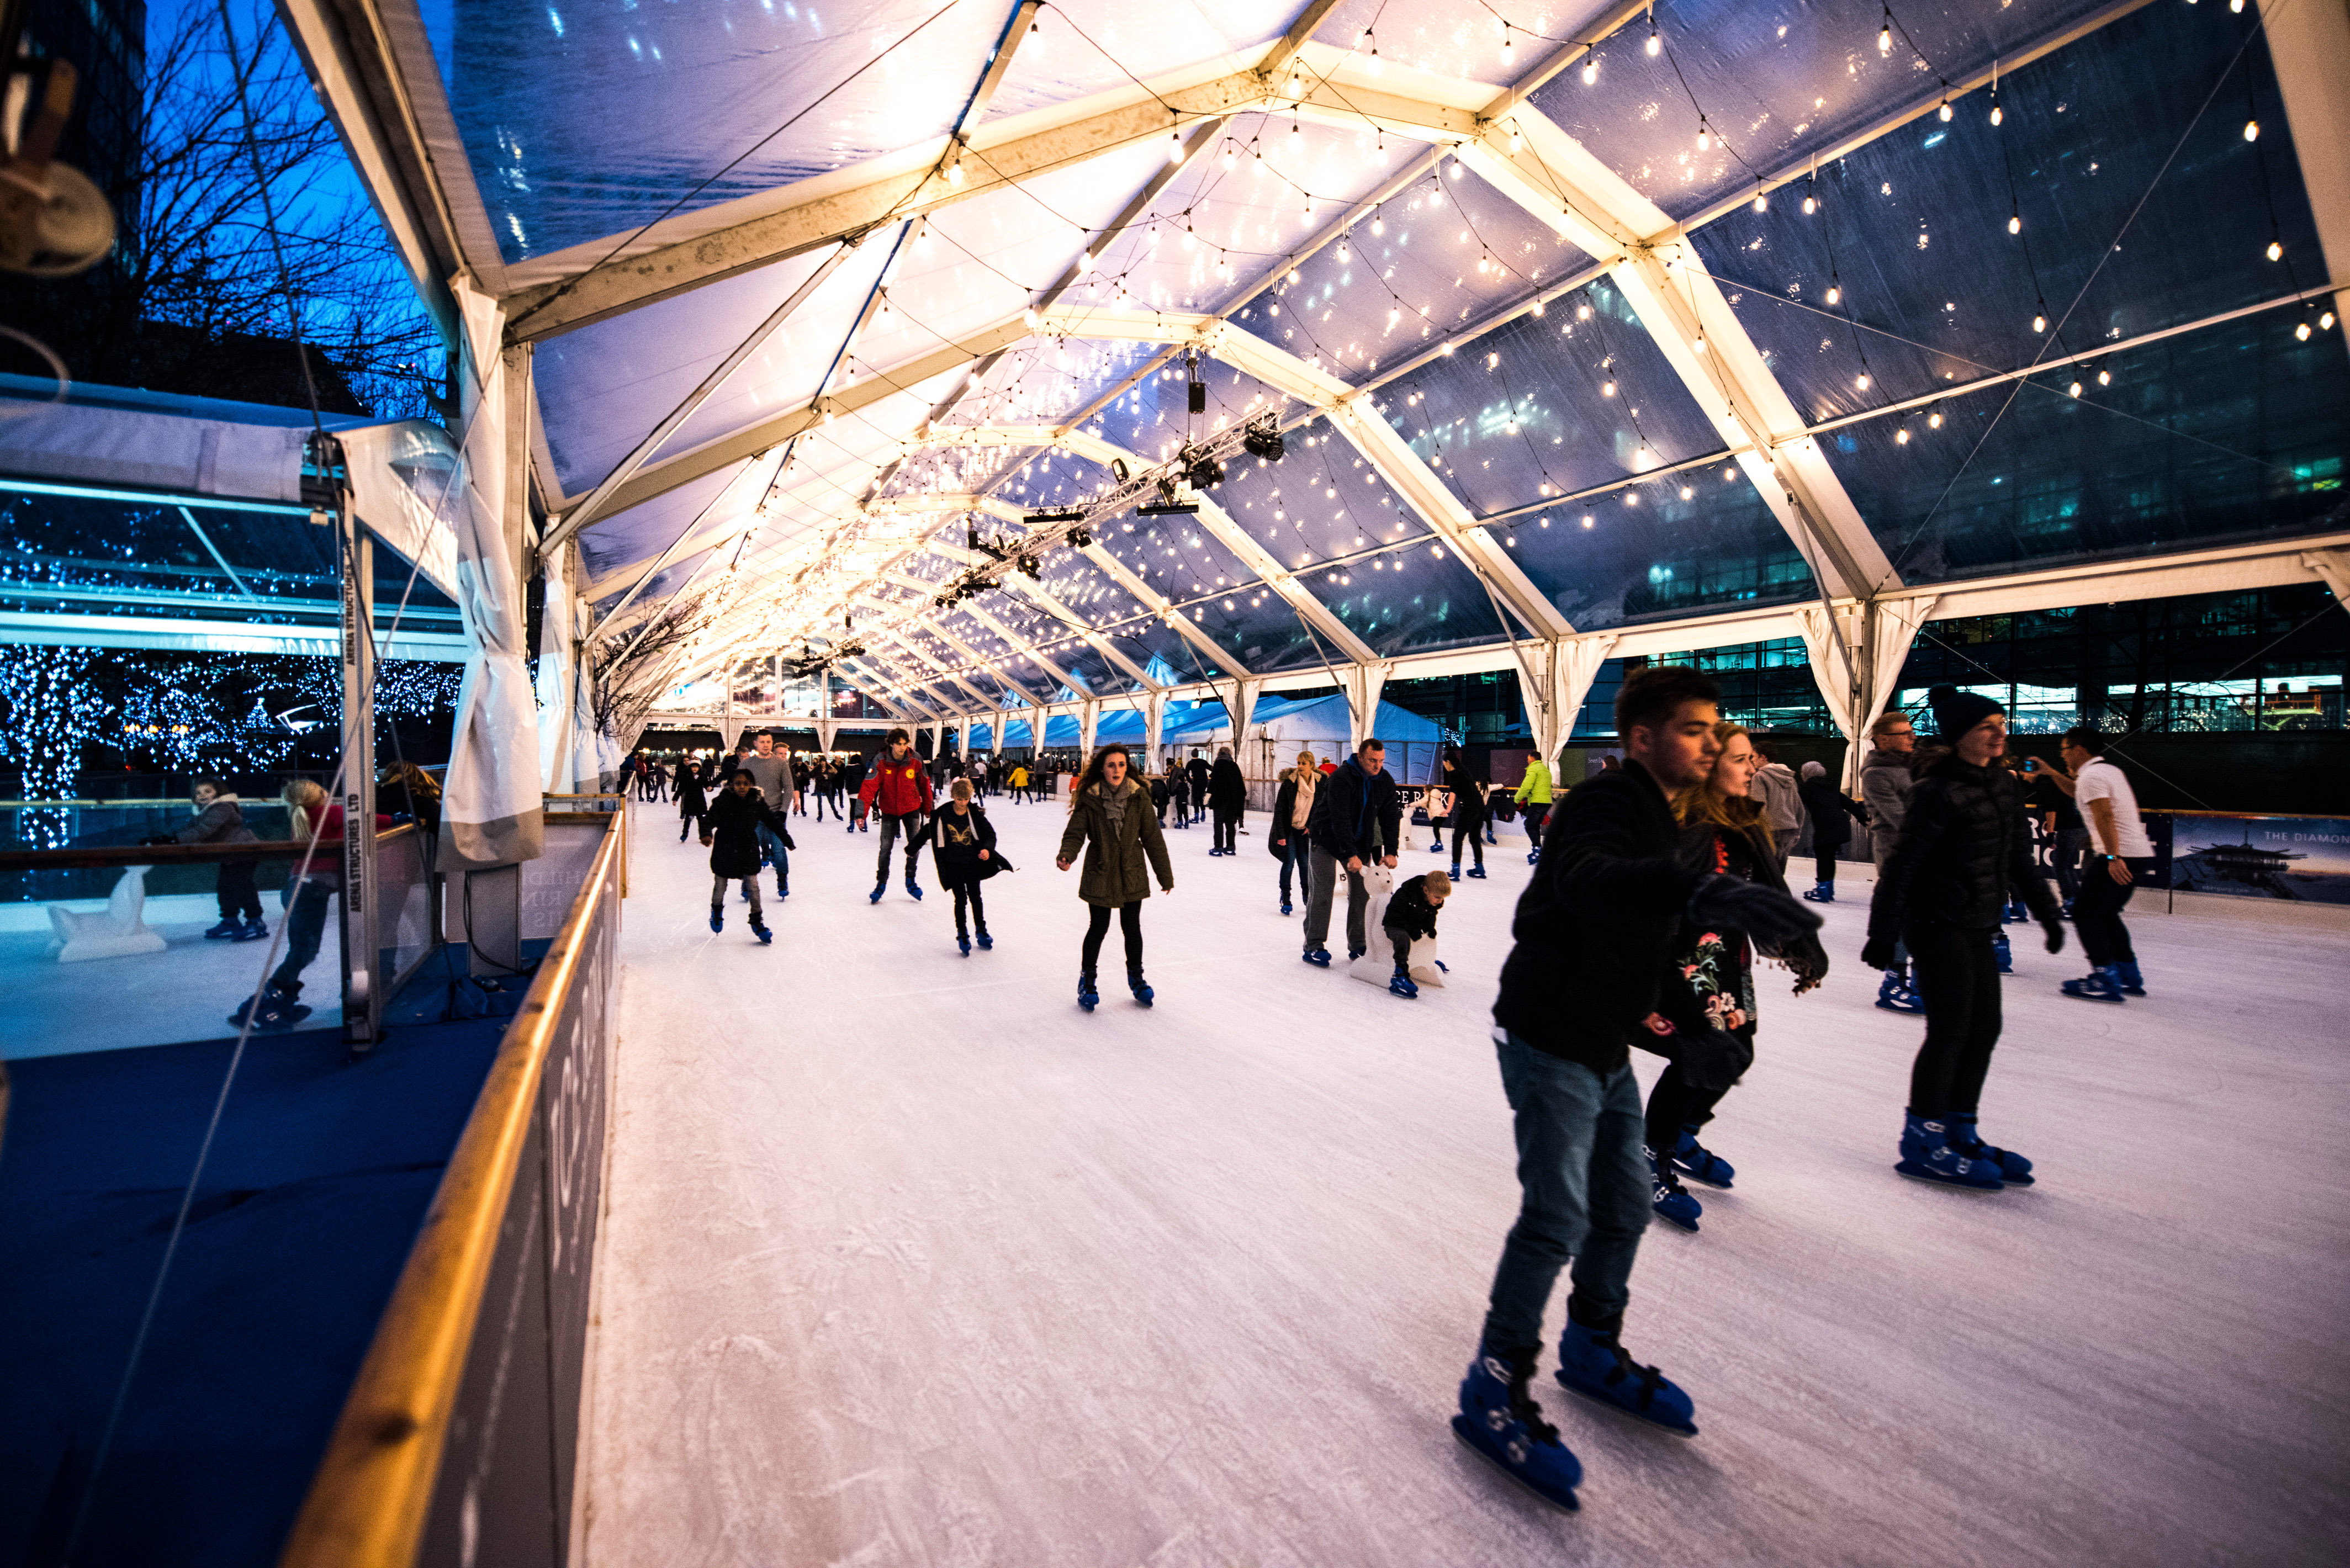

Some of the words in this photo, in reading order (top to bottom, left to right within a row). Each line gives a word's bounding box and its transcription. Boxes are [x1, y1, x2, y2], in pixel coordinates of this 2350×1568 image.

[345, 633, 355, 666] ARENA
[347, 793, 359, 812] LTD
[1395, 790, 1409, 803] CE
[1414, 791, 1449, 806] RK
[2264, 831, 2288, 841] THE
[348, 819, 361, 880] STRUCTURES
[350, 881, 362, 913] ARENA
